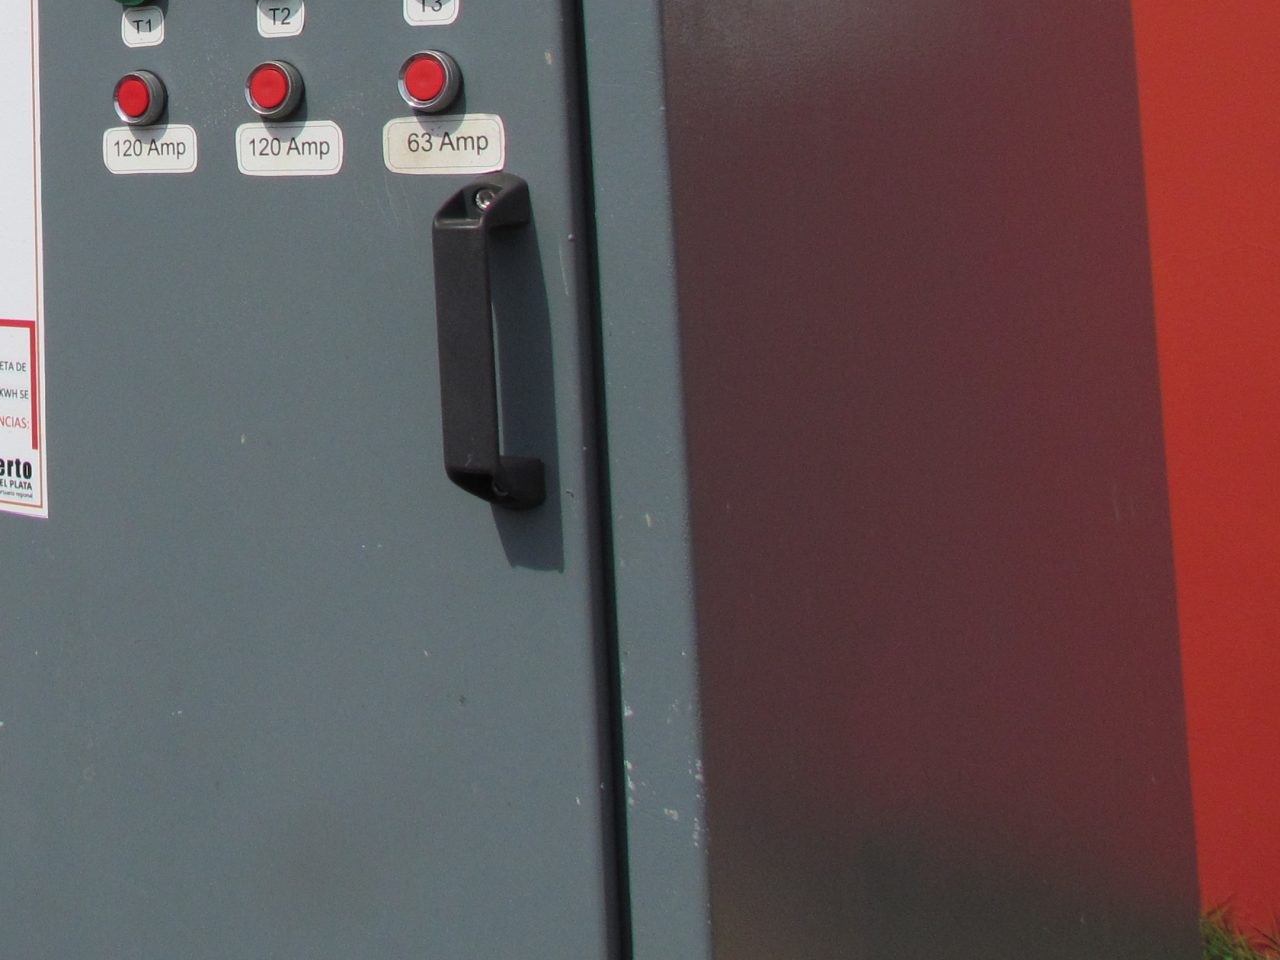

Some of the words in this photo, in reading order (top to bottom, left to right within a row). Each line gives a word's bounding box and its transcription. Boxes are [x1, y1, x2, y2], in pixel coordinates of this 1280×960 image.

[133, 19, 152, 33] T1
[268, 7, 292, 26] T2
[114, 140, 142, 158] 120
[147, 139, 186, 158] Amp
[249, 138, 280, 157] 120
[286, 137, 330, 158] Amp
[407, 133, 432, 153] 63
[439, 131, 489, 155] Amp
[9, 479, 32, 490] PLATA
